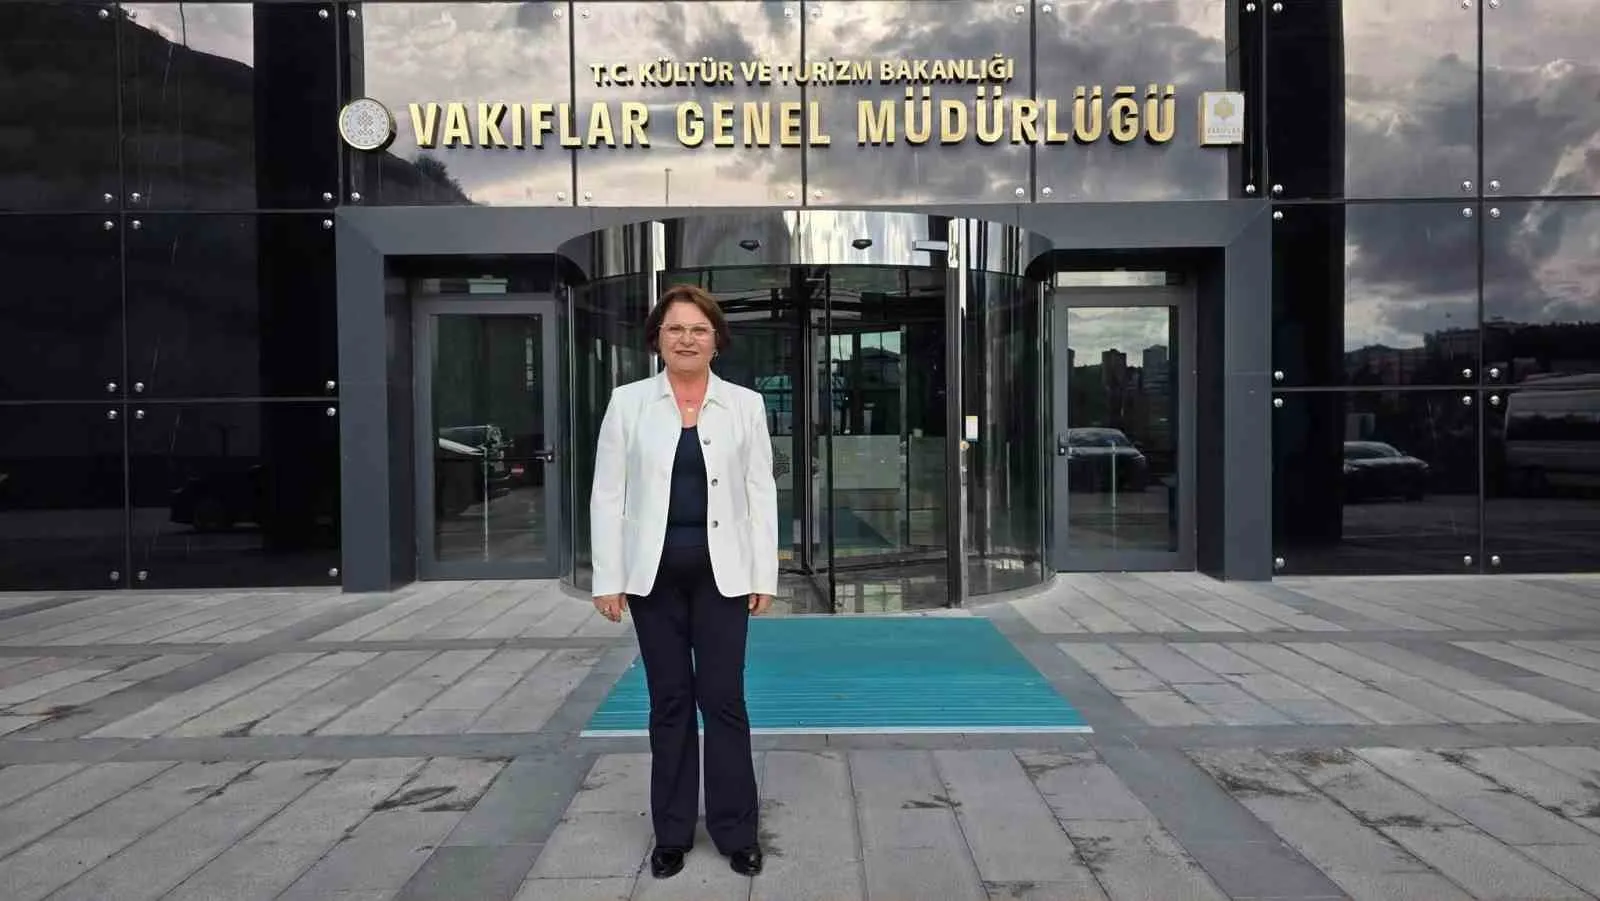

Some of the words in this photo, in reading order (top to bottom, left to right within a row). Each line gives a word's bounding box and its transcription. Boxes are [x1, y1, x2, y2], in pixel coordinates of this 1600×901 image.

[590, 62, 633, 84] T.C.
[639, 55, 734, 84] KÜLTÜR
[740, 61, 772, 83] VE
[778, 57, 873, 83] TURİZM
[880, 53, 1014, 82] BAKANLIĞI
[408, 102, 650, 147] VAKIFLAR
[676, 100, 831, 146] GENEL
